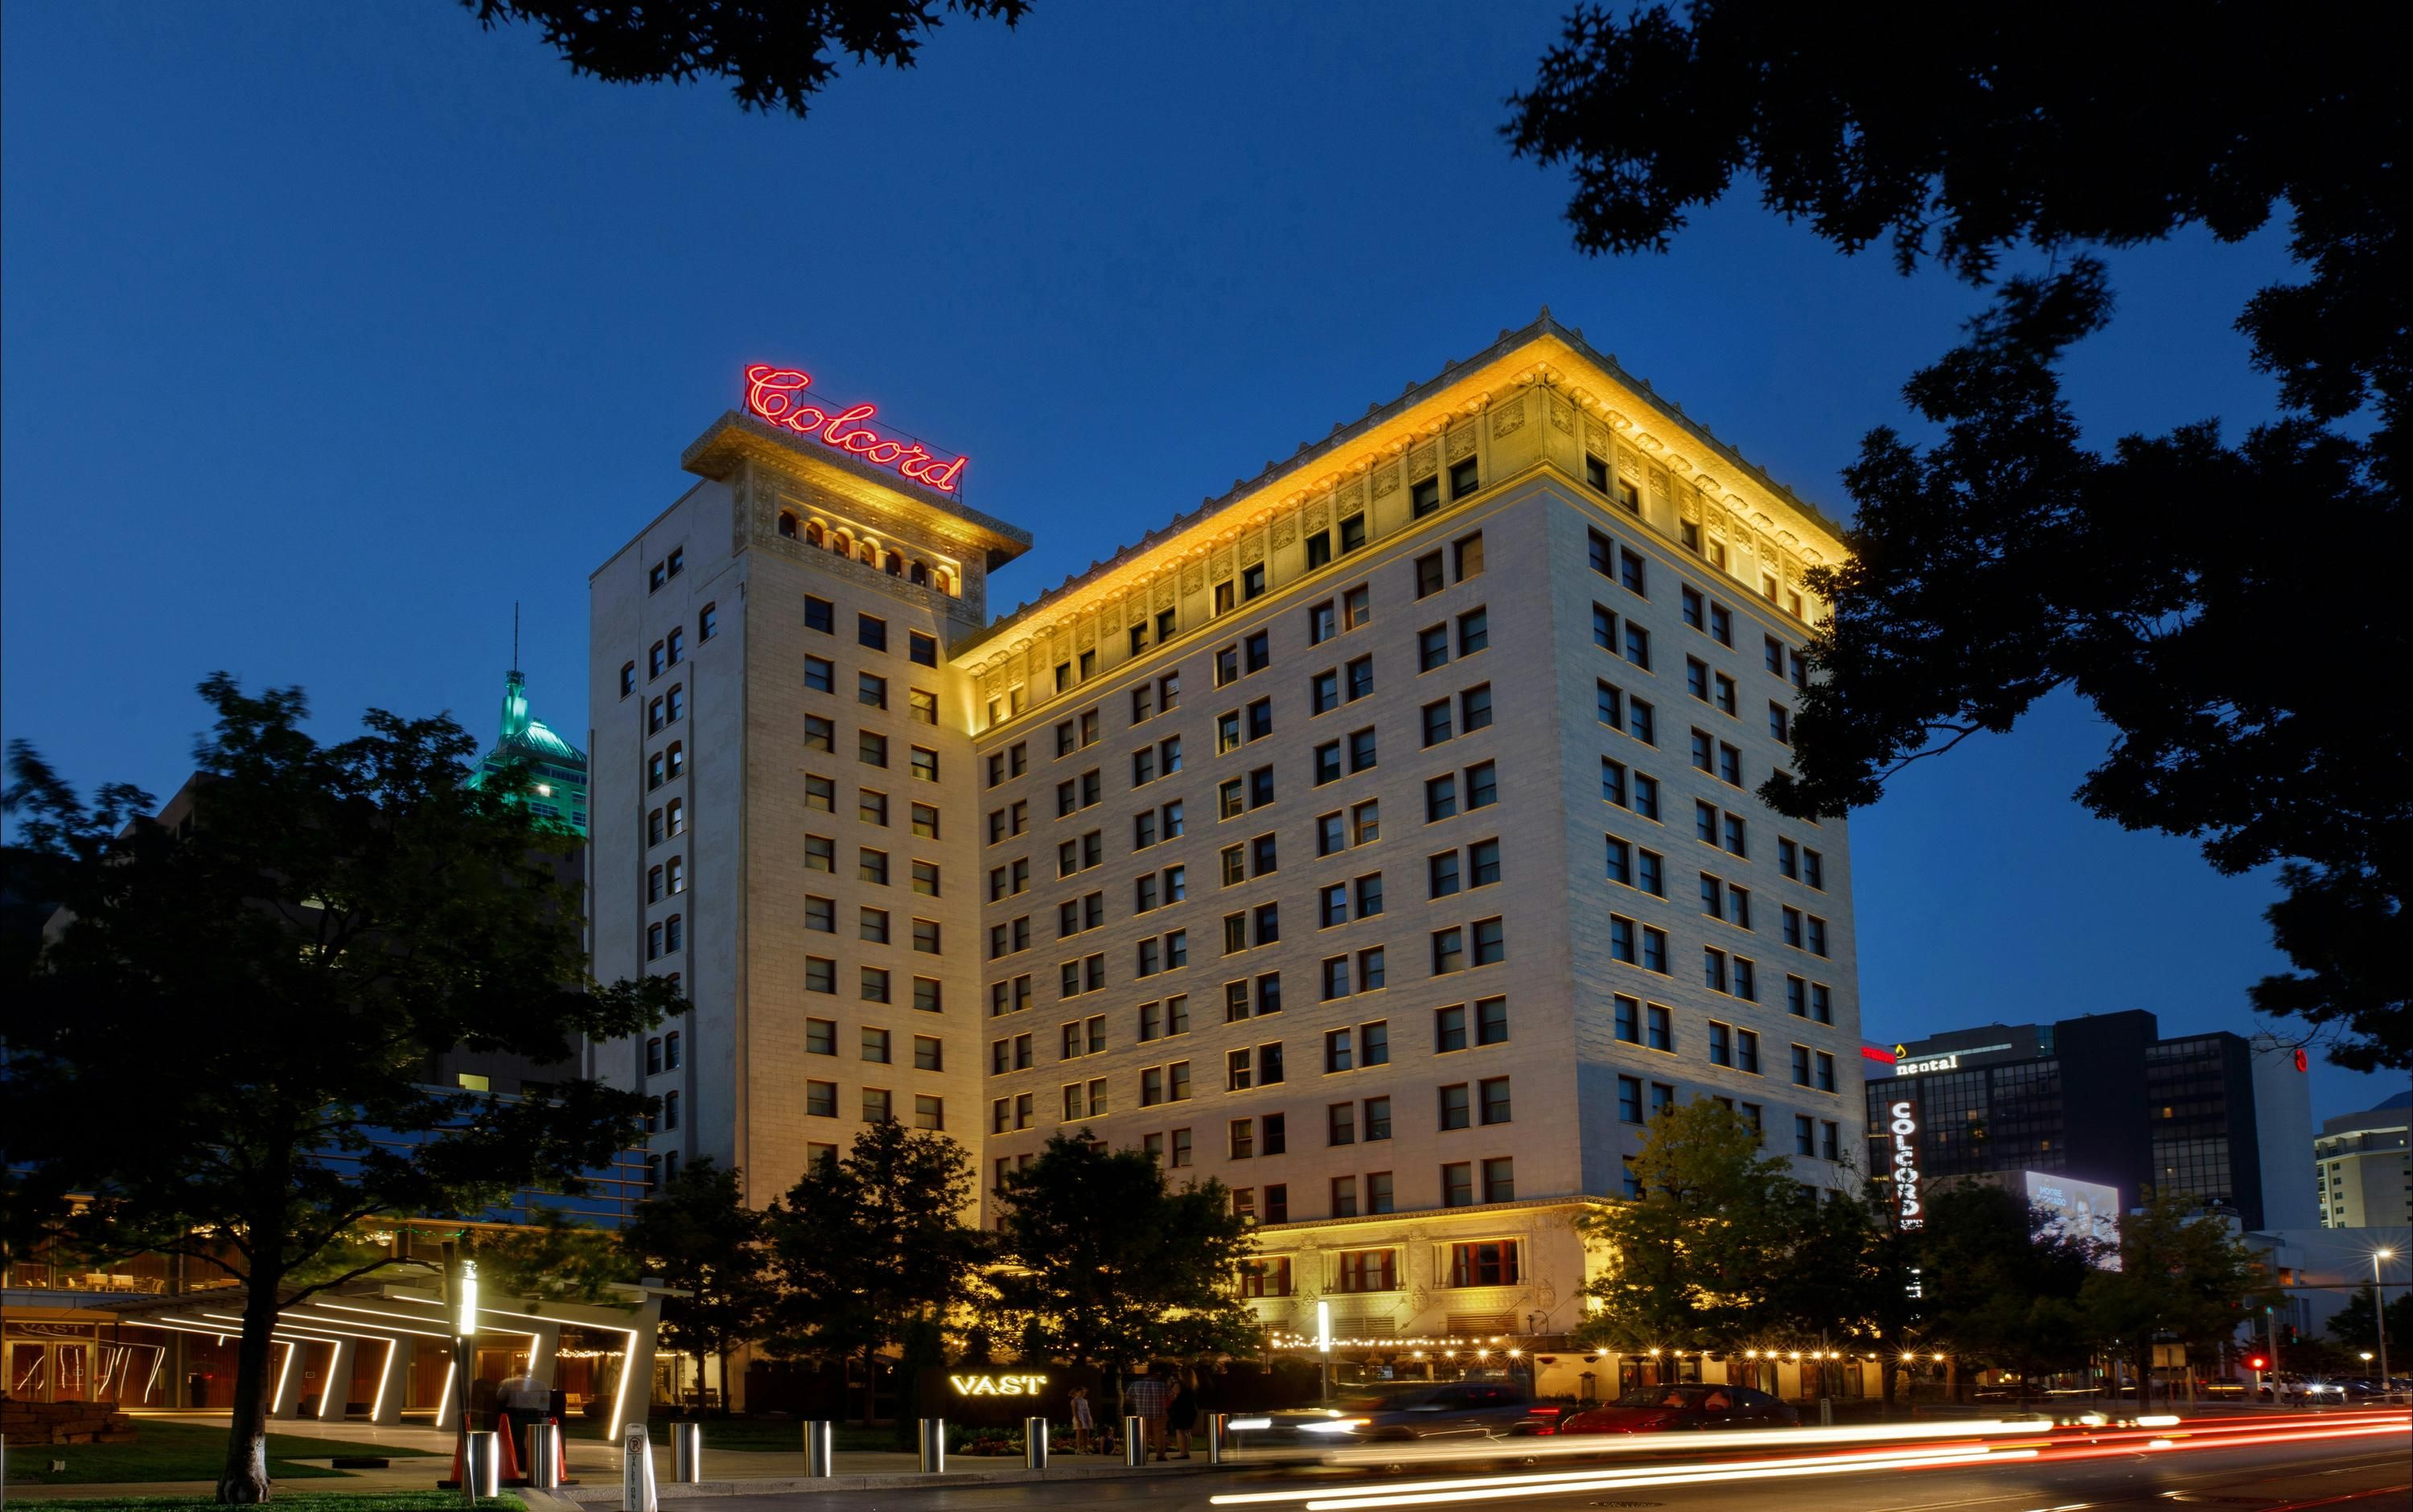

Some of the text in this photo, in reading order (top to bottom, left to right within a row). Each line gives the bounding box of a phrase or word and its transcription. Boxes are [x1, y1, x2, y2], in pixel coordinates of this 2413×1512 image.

[747, 364, 970, 492] Colcord
[1897, 1054, 1958, 1075] nental
[1891, 1102, 1920, 1216] COLCORD
[19, 1323, 84, 1334] VAST
[950, 1374, 1047, 1395] VAST
